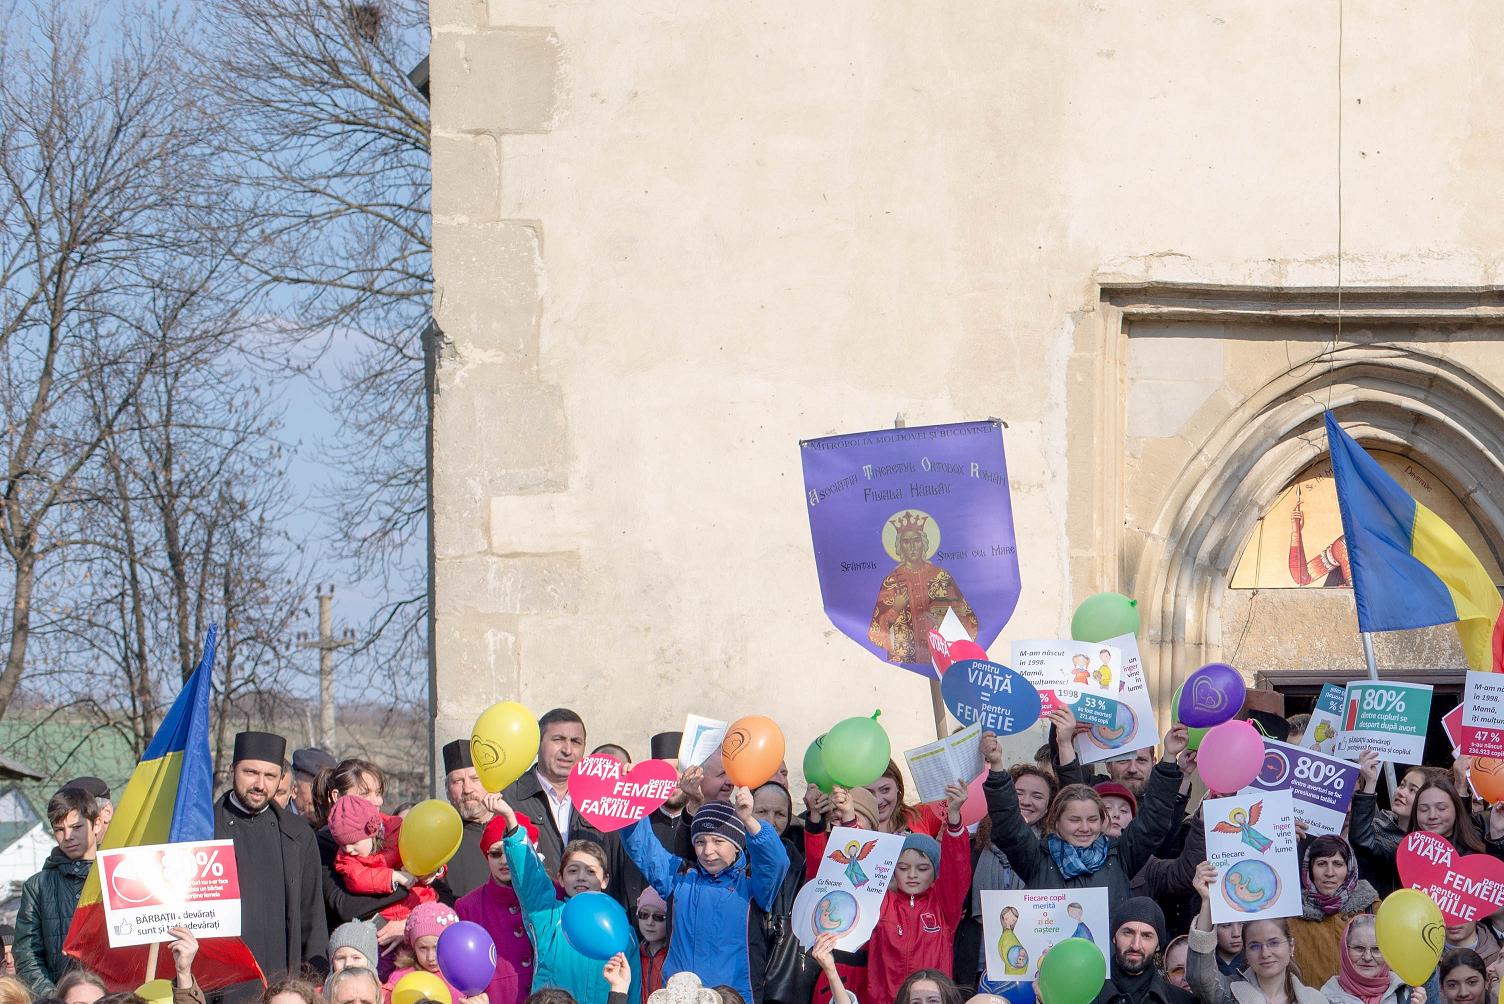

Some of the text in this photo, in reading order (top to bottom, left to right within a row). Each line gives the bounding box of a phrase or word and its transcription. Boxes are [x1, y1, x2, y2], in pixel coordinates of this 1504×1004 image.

[972, 661, 1000, 674] pentru
[967, 668, 1013, 694] VIAȚĂ
[1474, 683, 1495, 691] M-am
[1058, 689, 1078, 698] 1998
[1085, 697, 1106, 710] 53 %
[1363, 688, 1406, 712] 80%
[981, 703, 1011, 716] pentru
[1473, 705, 1497, 714] Mamă,
[956, 702, 1015, 732] FEMEIE
[1399, 724, 1416, 732] avort
[1475, 731, 1500, 742] 47 %
[583, 757, 613, 765] pentru
[577, 761, 621, 780] VIAȚĂ
[1294, 756, 1346, 790] 80%
[648, 779, 677, 787] pentru
[613, 782, 672, 800] FEMEIE
[600, 796, 630, 806] pentru
[580, 799, 645, 819] FAMILIE
[1276, 830, 1291, 838] vine
[1413, 832, 1444, 848] pentru
[1407, 836, 1454, 868] VIAȚĂ
[1024, 894, 1066, 902] Fiecare copil
[1430, 884, 1461, 901] pentru
[1032, 902, 1056, 910] merită
[138, 926, 156, 936] sunt
[1034, 926, 1060, 935] naștere
